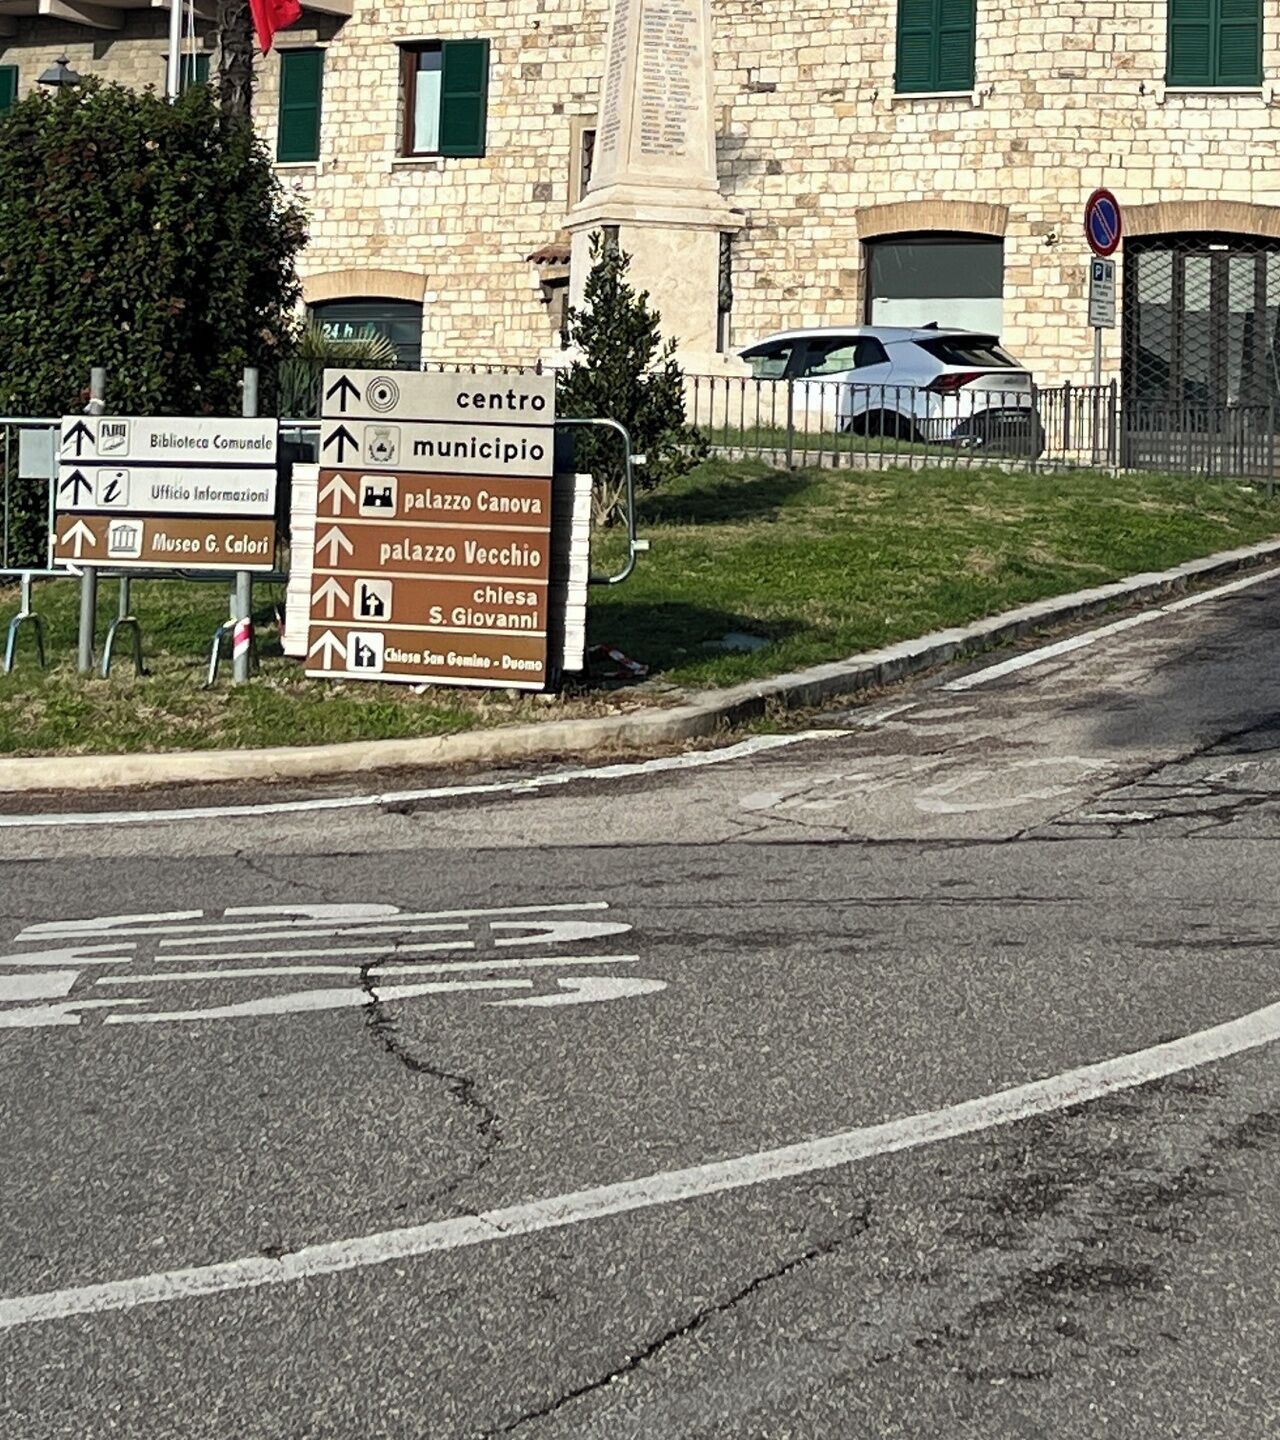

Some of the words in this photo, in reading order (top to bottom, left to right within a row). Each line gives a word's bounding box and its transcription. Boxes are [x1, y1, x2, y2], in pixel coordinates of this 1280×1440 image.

[322, 323, 340, 339] 24
[456, 389, 546, 411] centro
[150, 433, 209, 450] Biblioteca
[213, 434, 273, 451] Comunale
[413, 436, 545, 463] municipio
[151, 484, 190, 501] Ufficio
[193, 485, 269, 503] Informazioni
[404, 488, 471, 513] palazzo
[476, 490, 542, 514] Canova
[152, 533, 200, 553] Museo
[205, 534, 220, 554] G.
[225, 535, 269, 555] Calori
[380, 538, 456, 566] palazzo
[464, 540, 541, 568] Vecchio
[473, 585, 538, 606] chiesa
[429, 606, 448, 625] S.
[452, 607, 538, 629] Giovanni
[384, 647, 421, 664] Chiesa
[423, 649, 444, 665] San
[502, 655, 543, 672] Duomo
